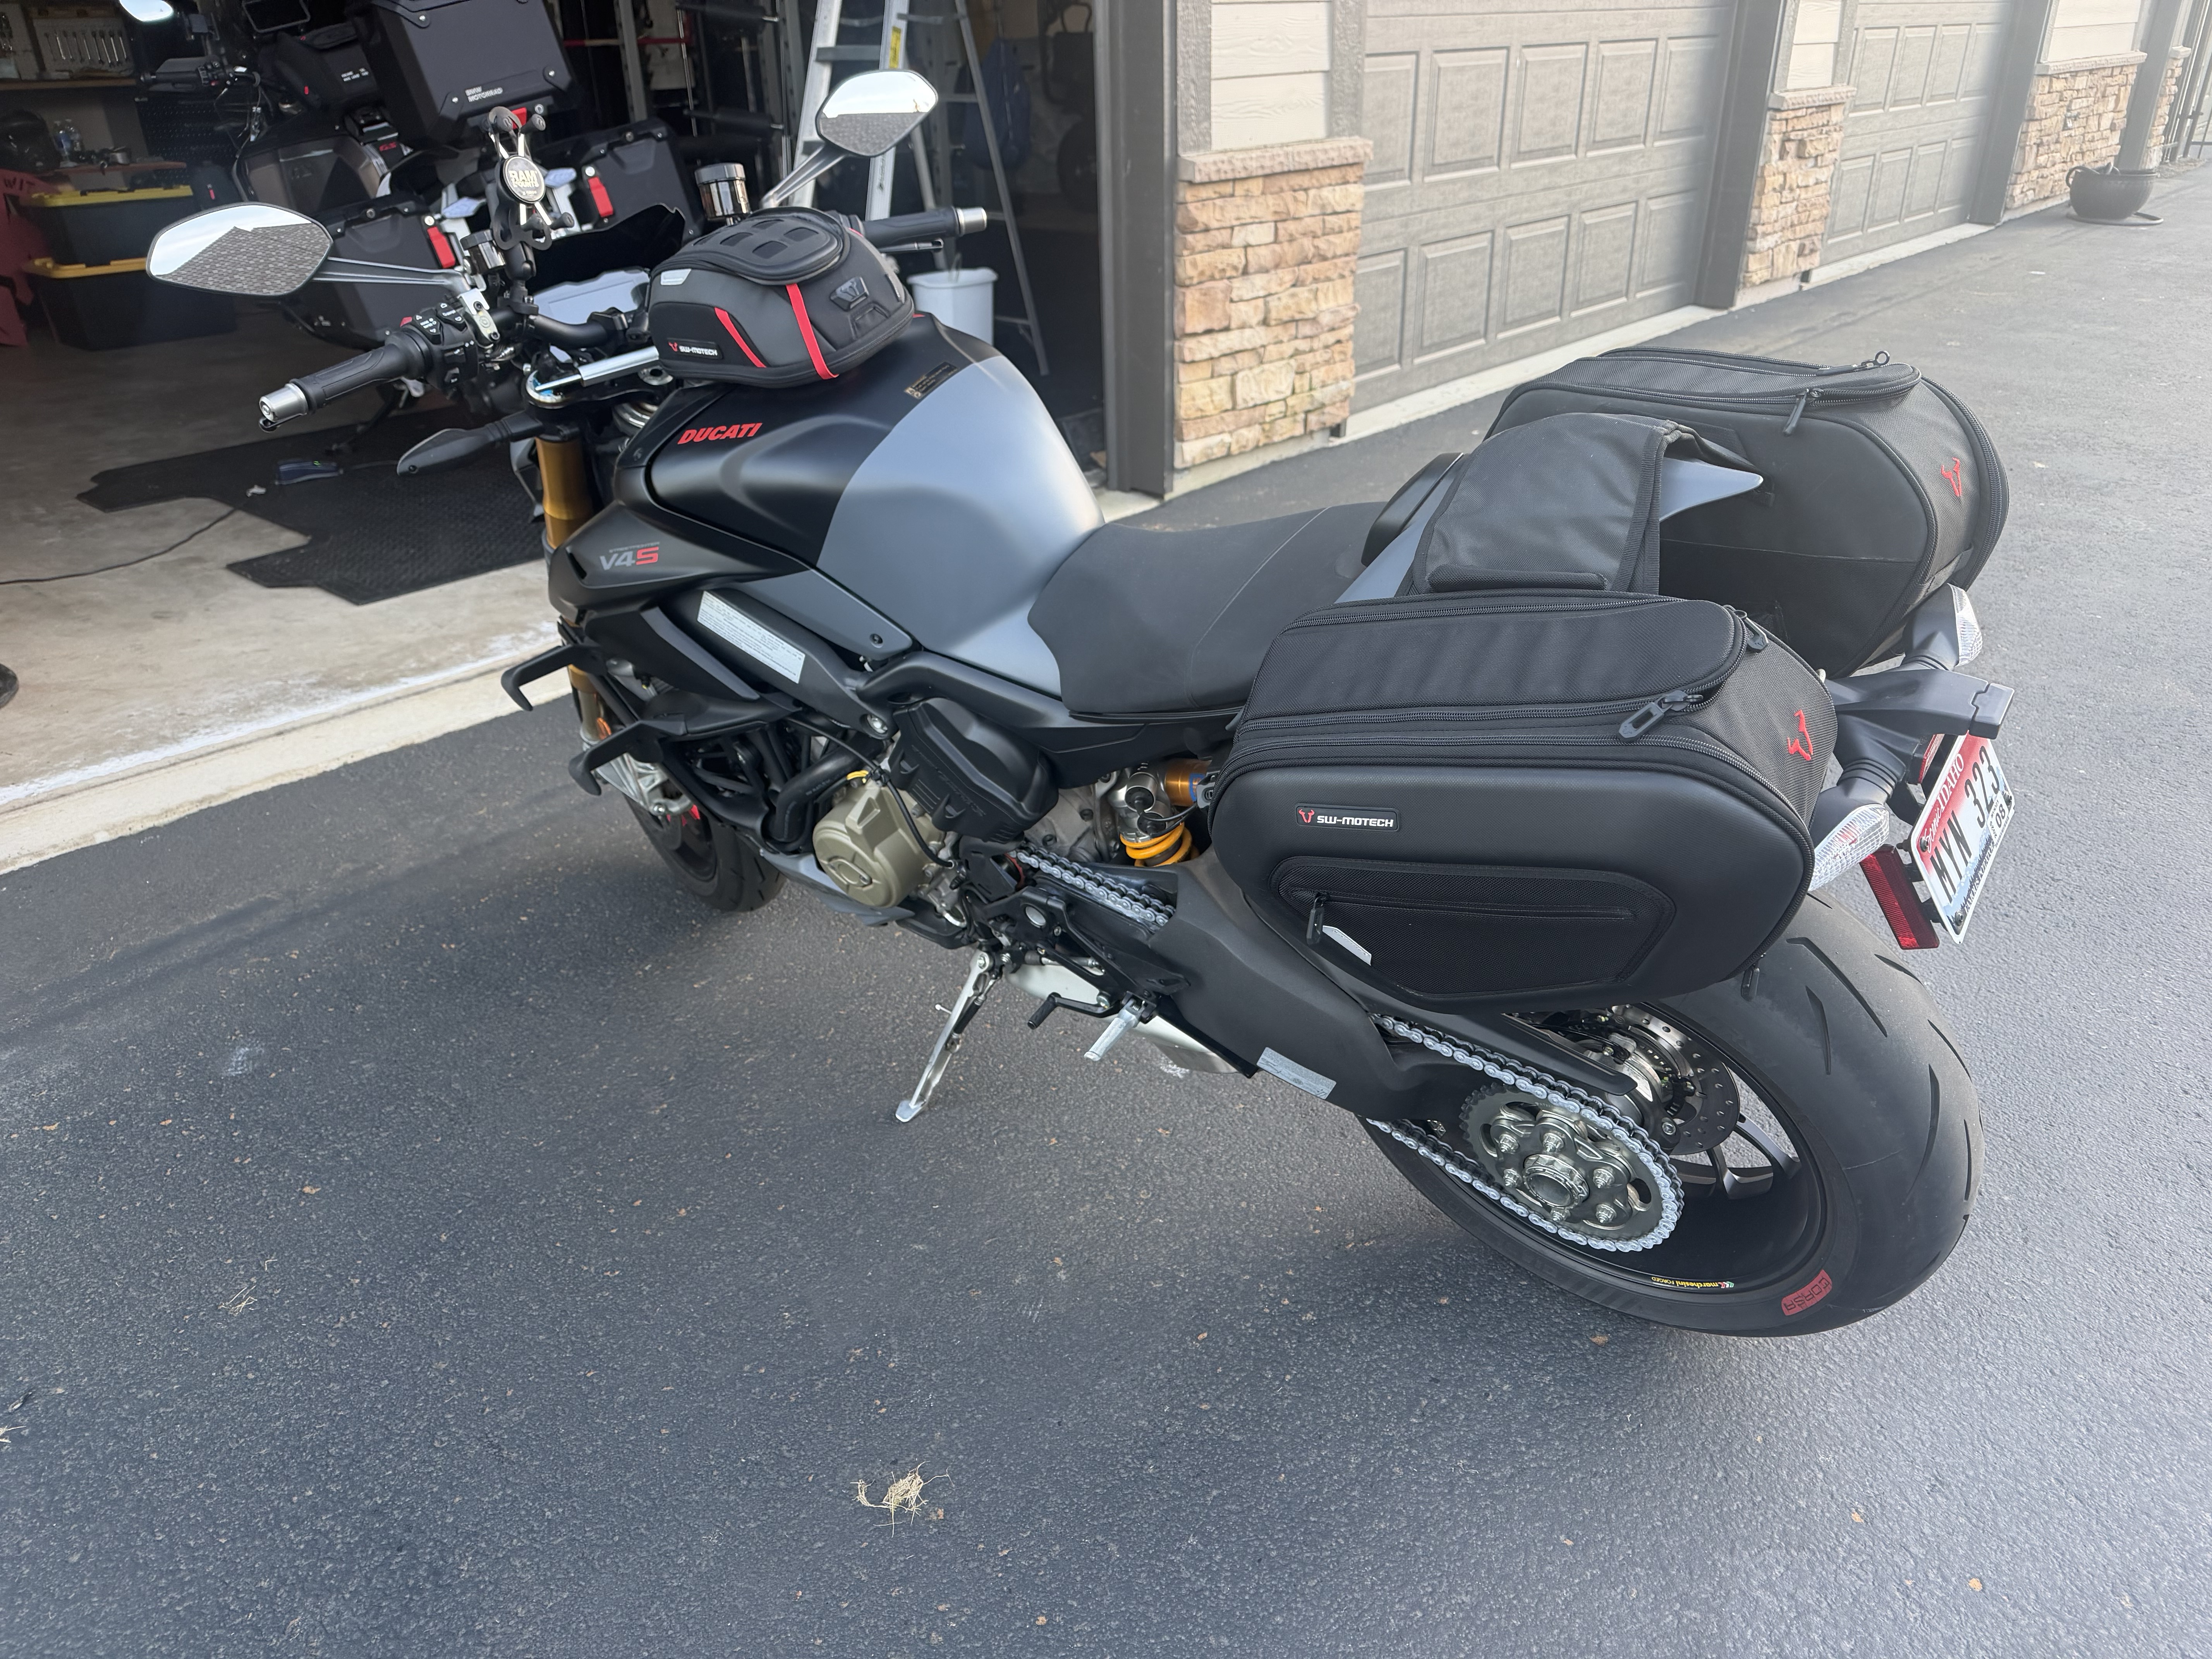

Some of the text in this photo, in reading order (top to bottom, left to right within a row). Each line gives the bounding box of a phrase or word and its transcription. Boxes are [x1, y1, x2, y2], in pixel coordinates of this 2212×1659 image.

[508, 170, 537, 182] RAM
[678, 345, 718, 356] SW-MOTECH
[677, 422, 763, 444] DUCATI
[599, 546, 659, 570] V4S
[1937, 753, 1964, 813] IDAHO
[1317, 815, 1394, 827] SW-MOTECH
[1930, 745, 2000, 904] MYN 323
[1995, 804, 2006, 828] 08
[1964, 877, 1979, 914] FAMOUS
[1651, 1276, 1719, 1289] marchesini FORGED
[1783, 1276, 1830, 1310] CORSA
